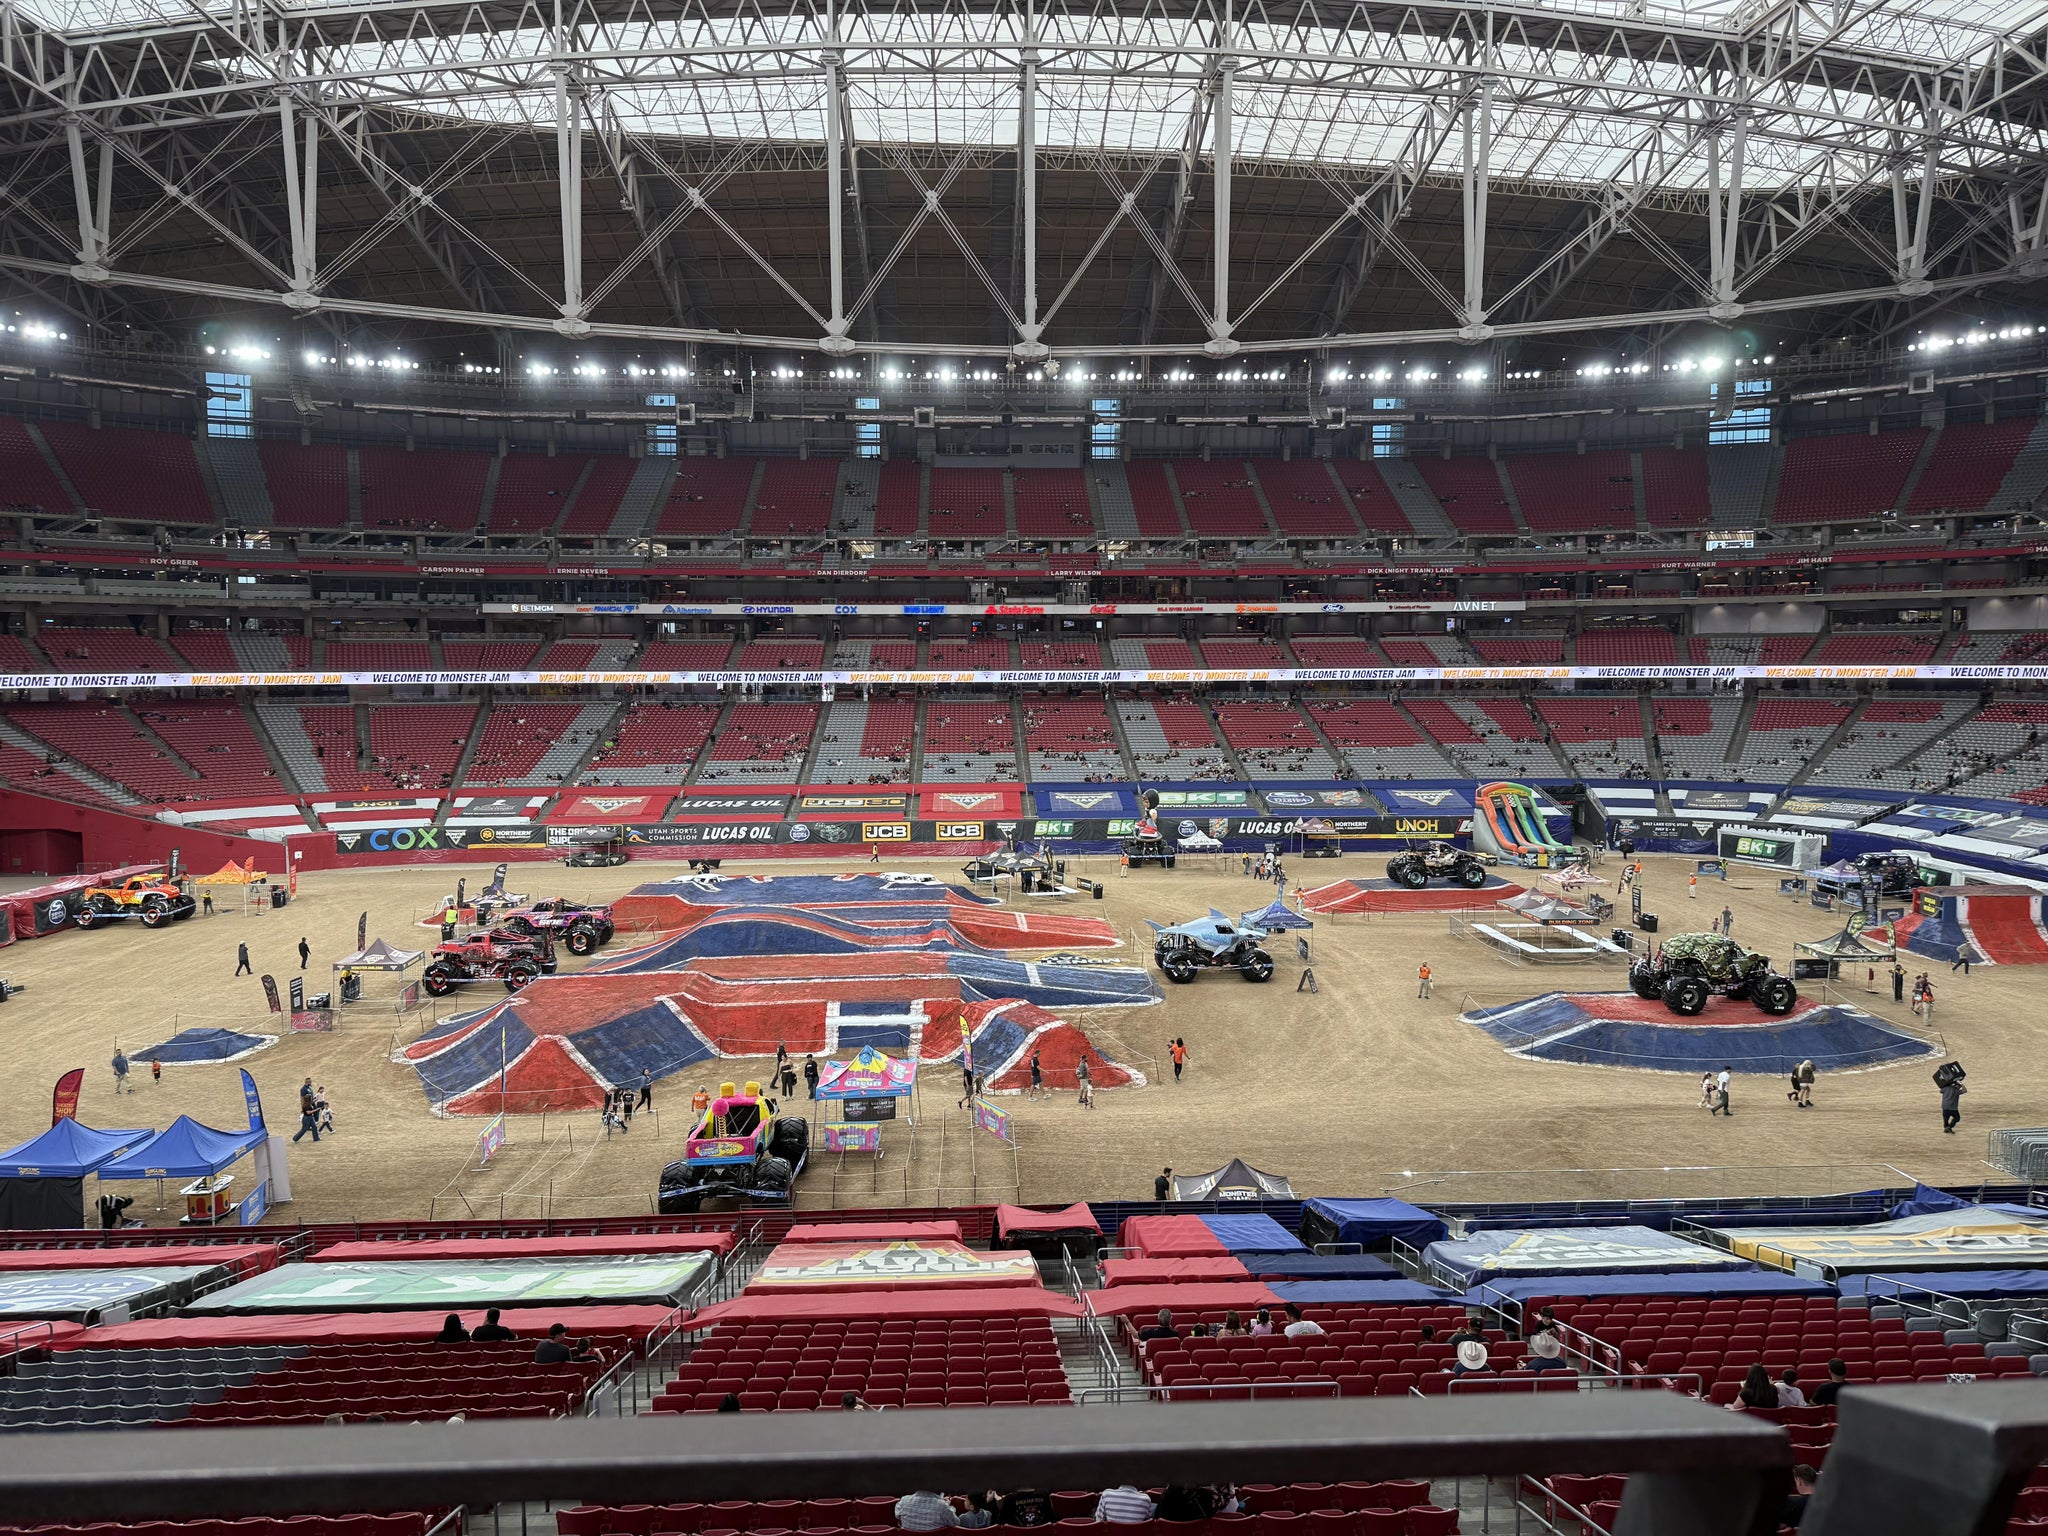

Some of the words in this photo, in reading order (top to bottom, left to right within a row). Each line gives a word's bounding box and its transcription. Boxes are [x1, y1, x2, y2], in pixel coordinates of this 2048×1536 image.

[1814, 556, 1834, 564] HART
[1383, 567, 1409, 575] (NIGHT
[1410, 567, 1434, 575] TRAIN)
[835, 605, 858, 614] COX
[999, 605, 1021, 614] State
[1022, 605, 1044, 614] Farm
[1452, 601, 1497, 611] AVNET
[1000, 672, 1042, 681] WELCOME
[1045, 672, 1055, 681] TO
[1057, 671, 1099, 681] MONSTER
[1101, 671, 1121, 681] JAM
[1147, 672, 1190, 681] WELCOME
[1193, 672, 1204, 680] TO
[1206, 672, 1248, 680] MONSTER
[1252, 671, 1270, 680] JAM
[1294, 670, 1337, 679] WELCOME
[1340, 670, 1350, 679] TO
[1352, 669, 1395, 679] MONSTER
[1396, 669, 1416, 678] JAM
[1442, 669, 1487, 678] WELCOME
[1490, 669, 1500, 678] TO
[1503, 669, 1546, 678] MONSTER
[1550, 669, 1570, 677] JAM
[1598, 667, 1646, 677] WELCOME
[1649, 667, 1660, 677] TO
[1663, 667, 1710, 677] MONSTER
[1713, 667, 1735, 677] JAM
[1766, 668, 1817, 677] WELCOME
[1820, 668, 1833, 677] TO
[1836, 668, 1889, 677] MONSTER
[1893, 668, 1917, 678] JAM
[1950, 667, 2004, 677] WELCOME
[2007, 667, 2020, 678] TO
[2022, 667, 2047, 678] MON
[0, 676, 50, 687] ELCOME
[54, 676, 68, 687] TO
[72, 675, 128, 686] MONSTER
[131, 675, 156, 686] JAM
[191, 675, 244, 685] WELCOME
[247, 675, 261, 685] TO
[264, 675, 316, 684] MONSTER
[320, 675, 343, 684] JAM
[373, 673, 423, 683] WELCOME
[426, 673, 438, 683] TO
[440, 673, 486, 682] MONSTER
[489, 673, 511, 682] JAM
[539, 673, 586, 683] WELCOME
[589, 673, 600, 682] TO
[603, 673, 648, 682] MONSTER
[651, 673, 671, 682] JAM
[697, 673, 742, 682] WELCOME
[745, 673, 755, 682] TO
[757, 673, 800, 682] MONSTER
[802, 673, 823, 682] JAM
[850, 673, 893, 682] WELCOME
[896, 673, 907, 682] TO
[910, 673, 953, 682] MONSTER
[956, 673, 974, 682] JAM
[1160, 792, 1245, 803] BKT
[352, 800, 400, 808] UNOH
[681, 800, 749, 808] LUCAS
[866, 824, 907, 838] JCB
[939, 823, 980, 837] JCB
[1036, 821, 1073, 834] BKT
[1108, 820, 1137, 834] BK
[1238, 821, 1280, 834] LUCAS
[1395, 820, 1439, 832] UNOH
[549, 827, 566, 836] THE
[702, 826, 748, 840] LUCAS
[369, 828, 438, 851] COX
[1738, 838, 1776, 857] BKT
